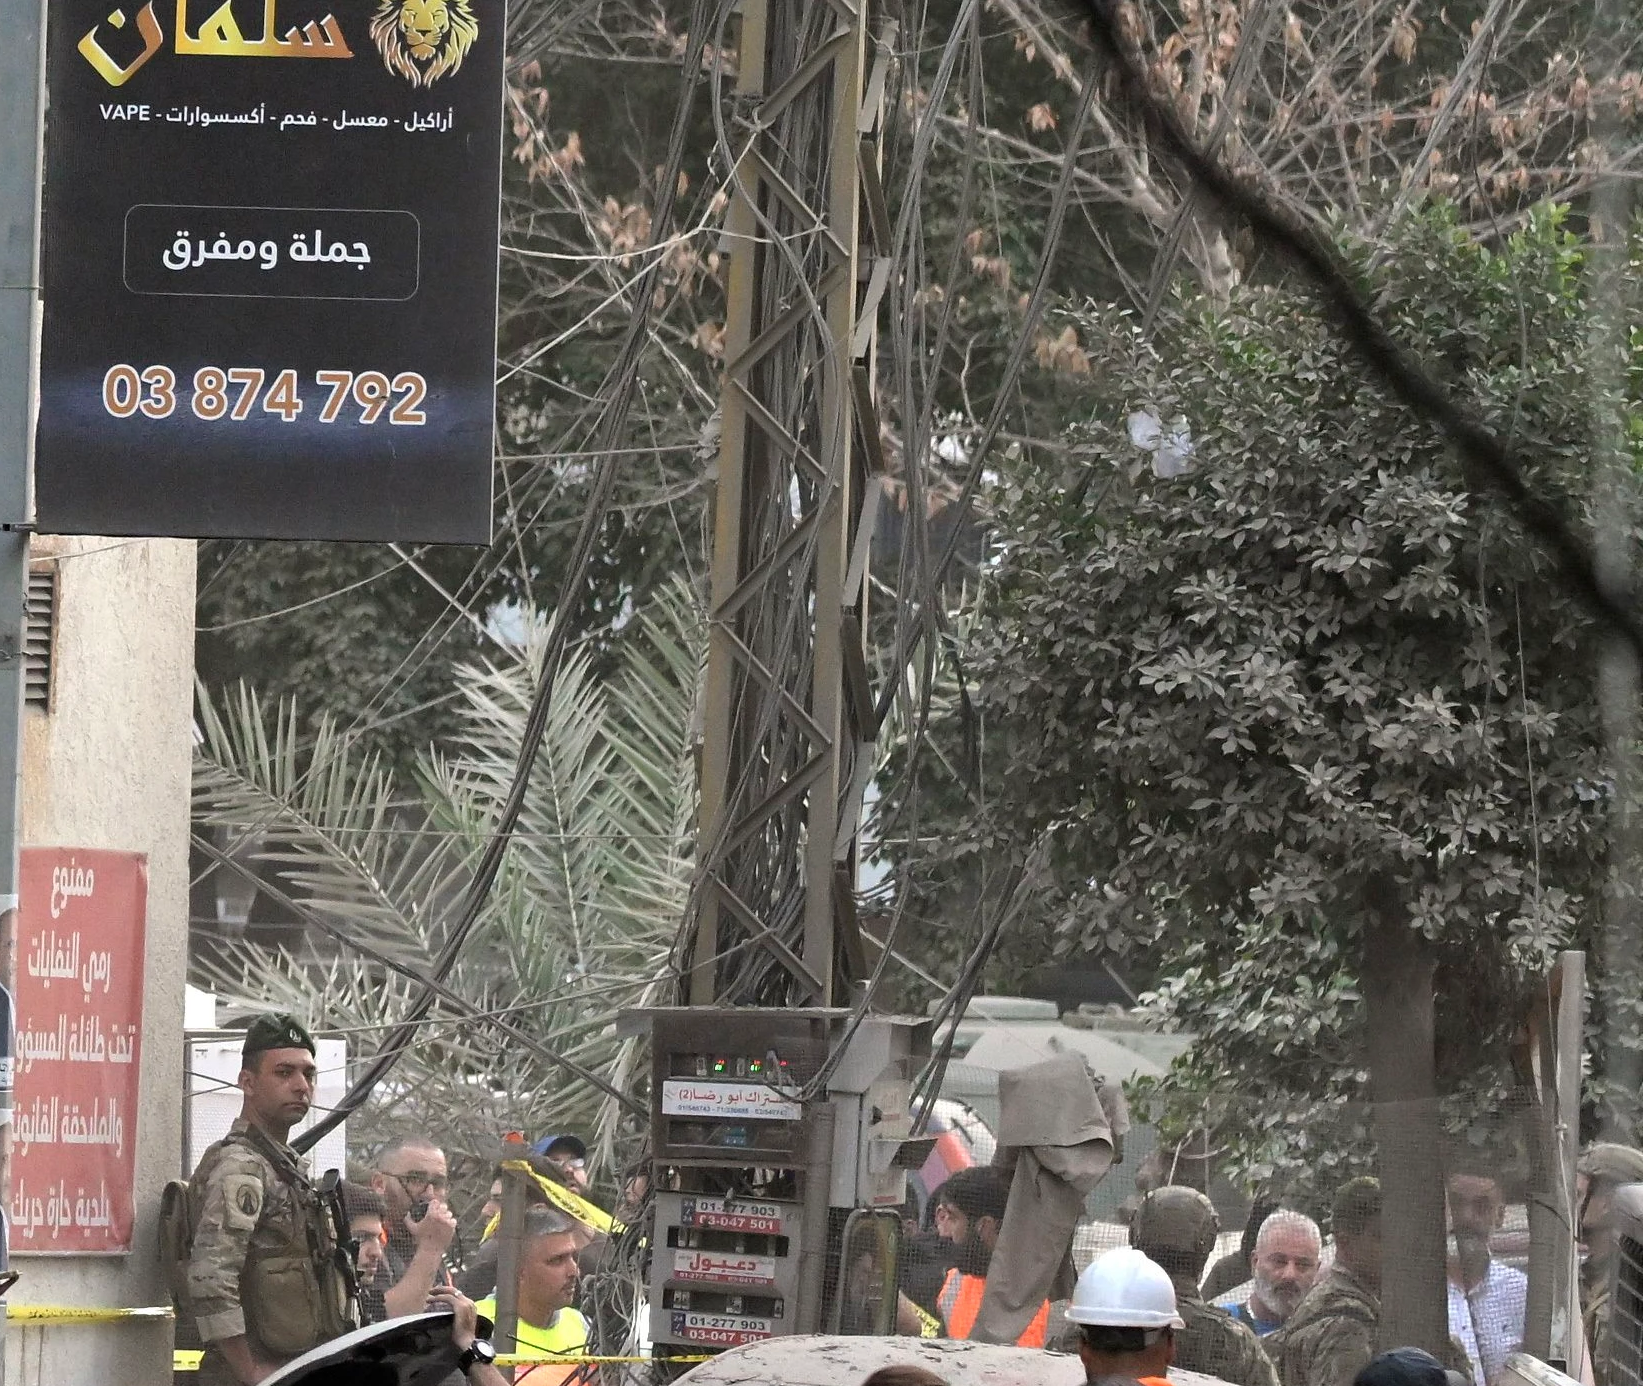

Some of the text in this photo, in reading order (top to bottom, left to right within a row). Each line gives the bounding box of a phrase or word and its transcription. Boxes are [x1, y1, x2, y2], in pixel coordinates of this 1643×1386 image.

[100, 104, 150, 121] VAPE
[166, 103, 265, 127] أكسسوارات
[280, 110, 316, 130] فحم
[333, 110, 388, 130] معسل
[404, 108, 454, 132] أراكيل
[162, 229, 371, 270] جملة ومفرق
[102, 364, 427, 425] 03 874 792
[51, 857, 94, 919] ممنوع
[28, 930, 111, 1003] رمي النفايات
[16, 1013, 136, 1073] تحت طائلة المسؤو
[61, 1097, 123, 1158] والملاحقة
[11, 1178, 109, 1239] بلدية حارة حريك
[700, 1201, 775, 1216] 01-77 903
[750, 1219, 773, 1230] 501
[689, 1329, 735, 1341] 03-047
[690, 1316, 765, 1330] 01-277 903
